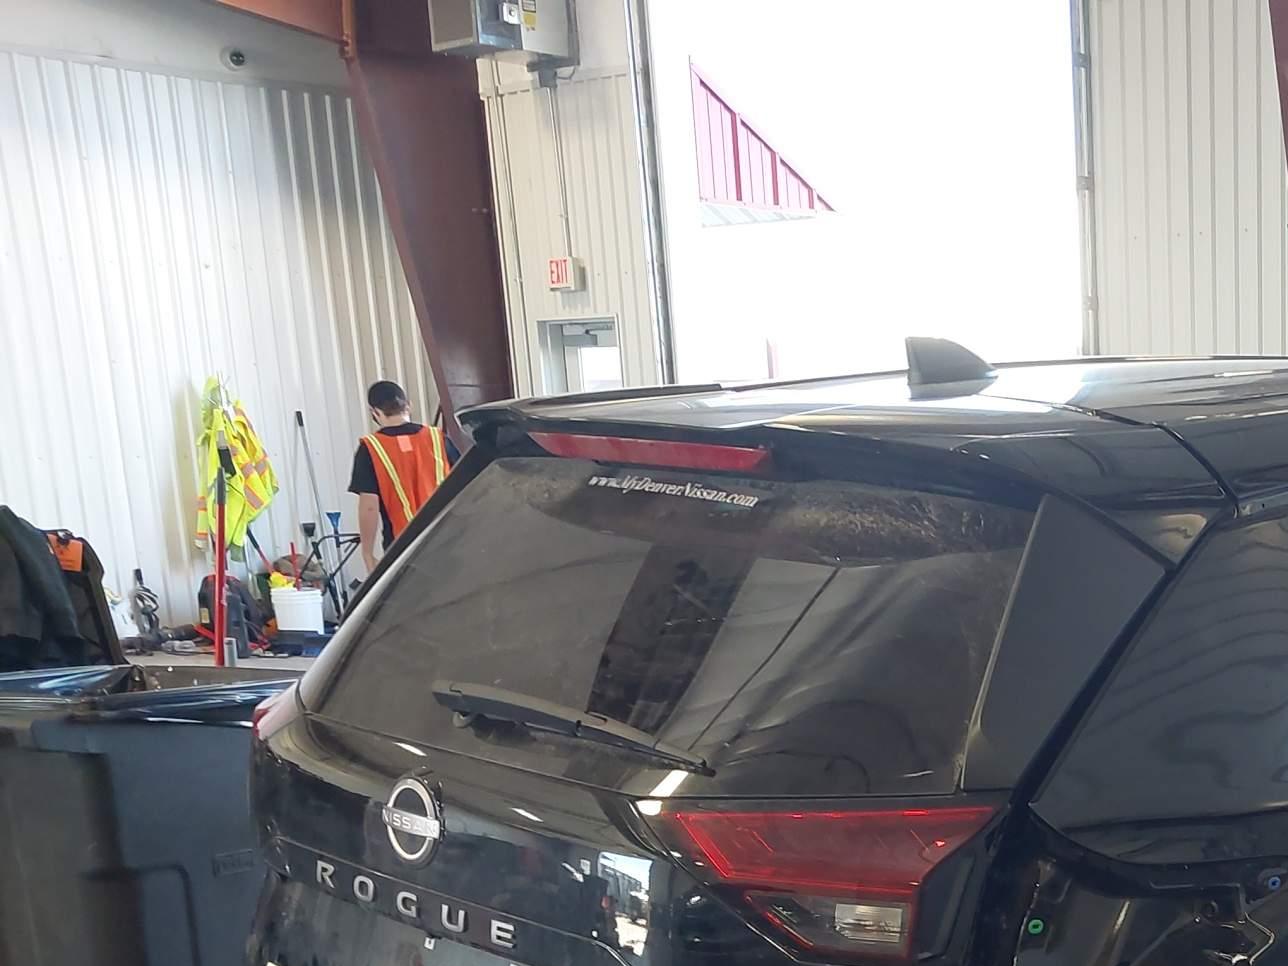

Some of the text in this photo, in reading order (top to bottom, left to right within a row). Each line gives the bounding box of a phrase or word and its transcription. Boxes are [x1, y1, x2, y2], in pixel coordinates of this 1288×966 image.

[549, 259, 568, 284] EXIT
[588, 474, 759, 508] www.MyDenverNissan.com
[382, 808, 439, 837] NISSAN
[316, 860, 516, 949] ROGUE
